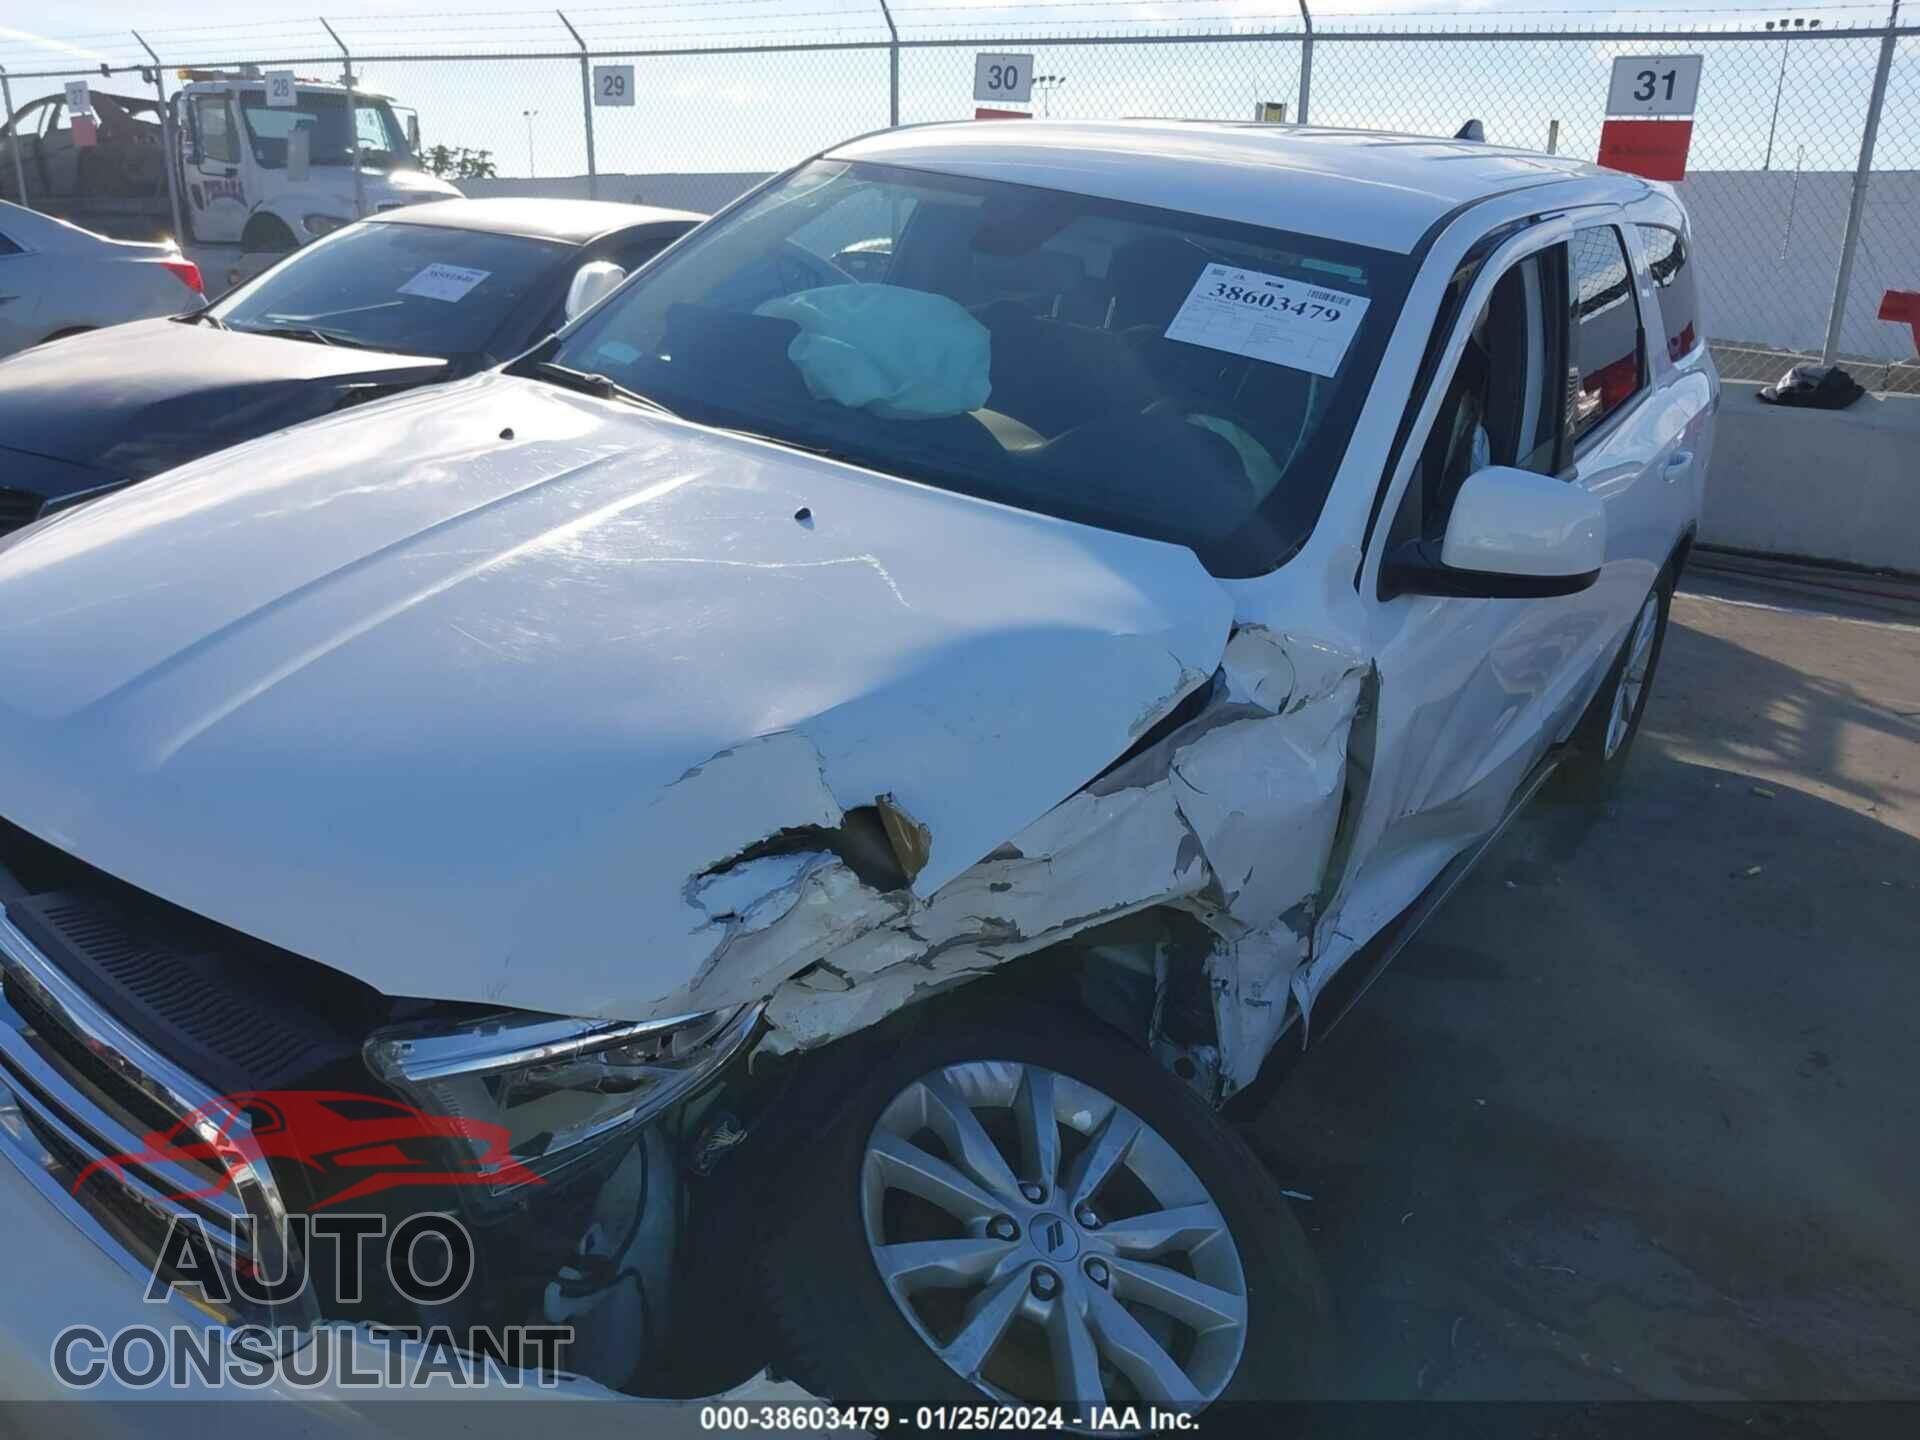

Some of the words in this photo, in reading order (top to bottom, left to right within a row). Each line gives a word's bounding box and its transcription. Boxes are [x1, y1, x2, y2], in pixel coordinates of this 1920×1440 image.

[273, 79, 289, 97] 28
[603, 75, 625, 97] 29
[988, 65, 1018, 90] 30
[1633, 70, 1677, 101] 31
[1208, 282, 1341, 322] 38603479
